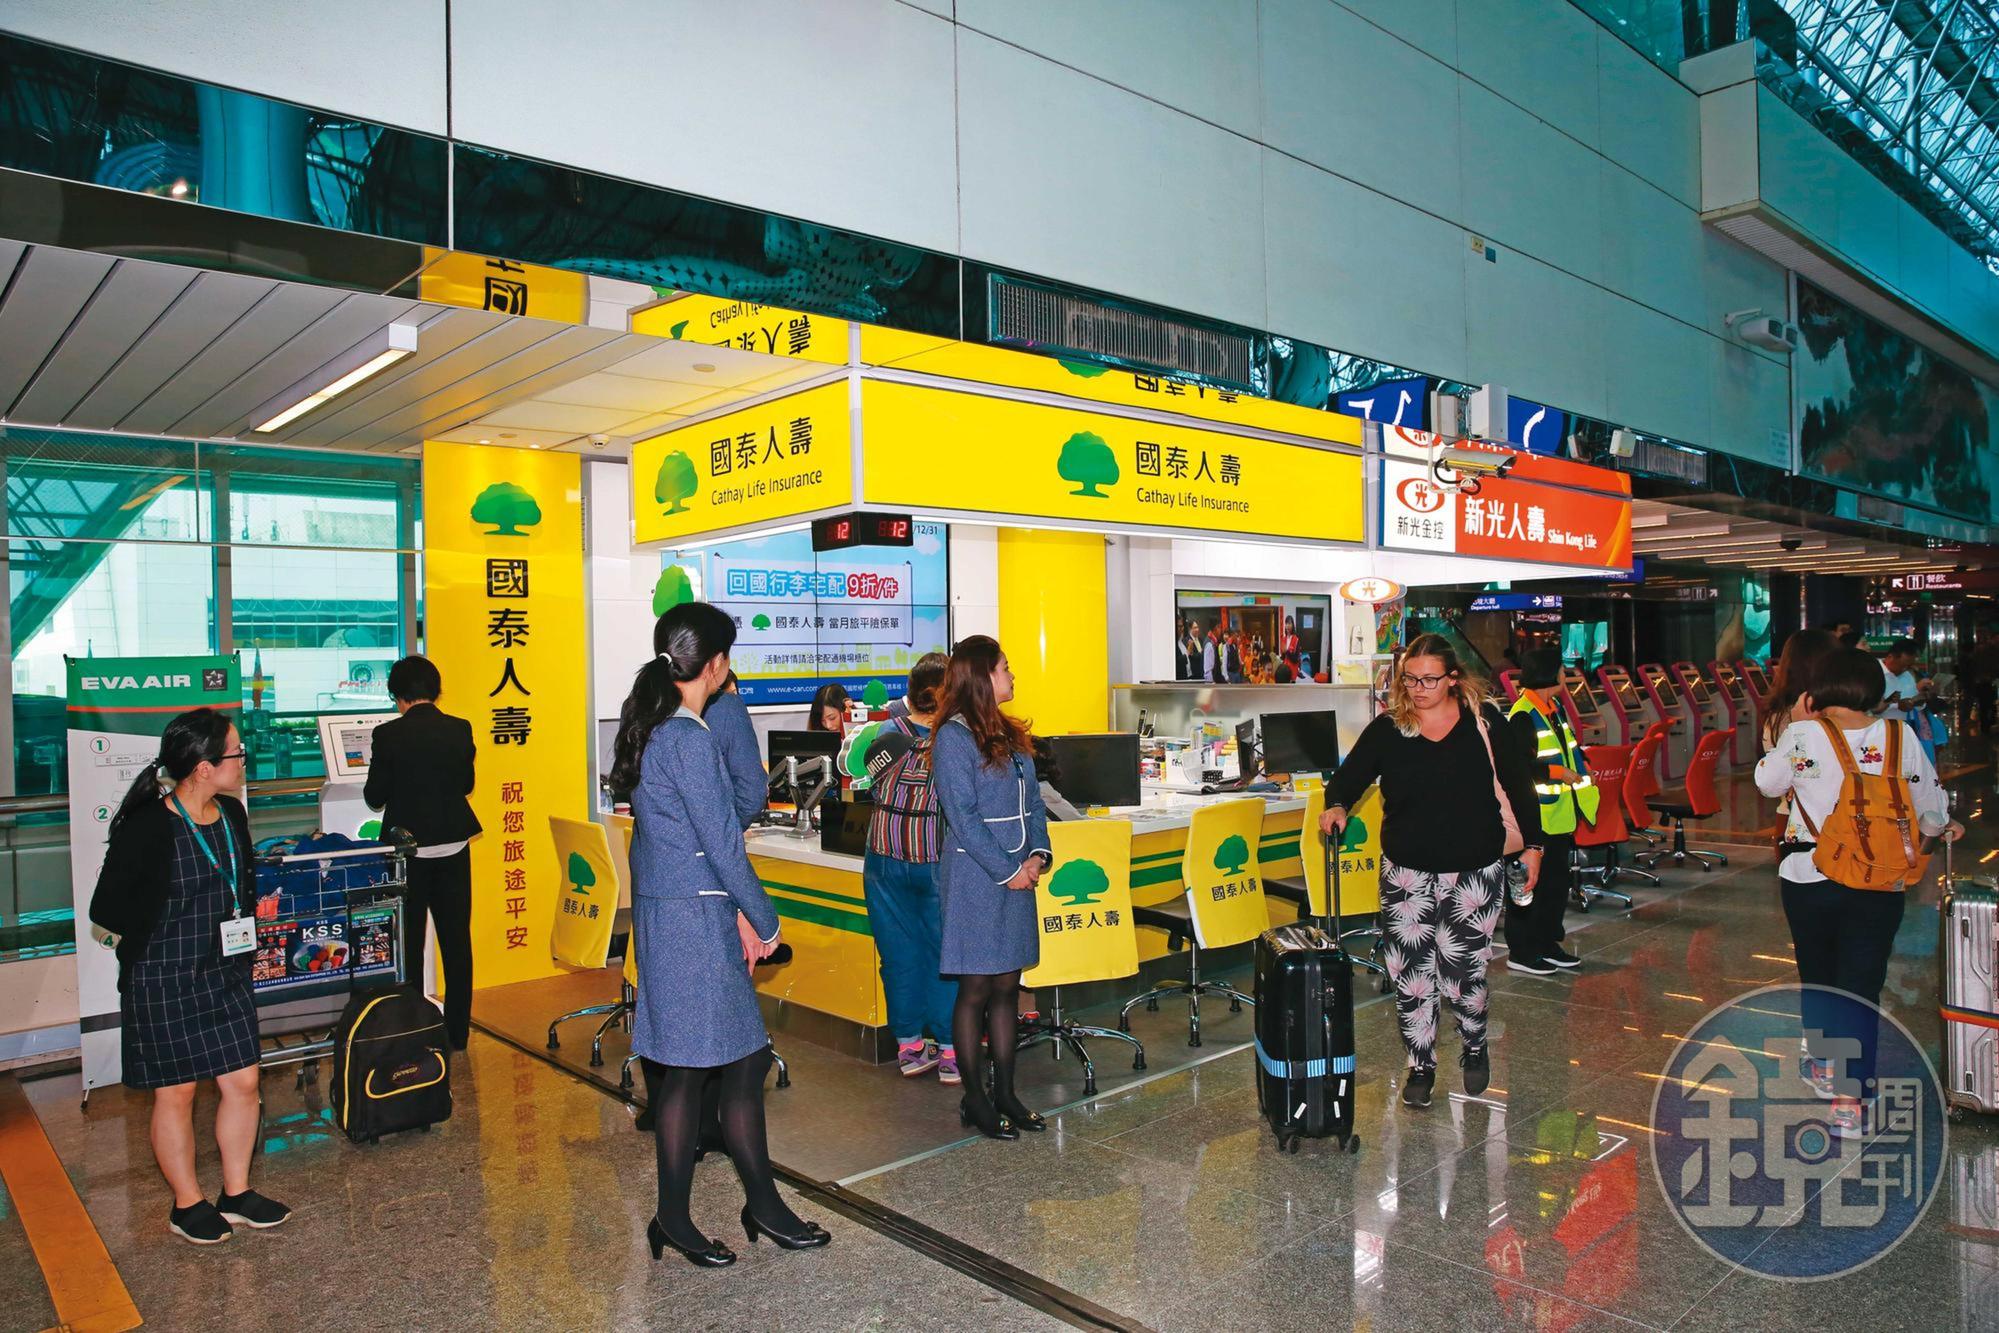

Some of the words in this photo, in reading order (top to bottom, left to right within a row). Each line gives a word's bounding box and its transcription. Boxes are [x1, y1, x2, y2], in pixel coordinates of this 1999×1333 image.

[710, 416, 813, 477] 國泰人壽
[1136, 441, 1241, 486] 國泰人壽
[711, 483, 745, 506] Cathay
[747, 480, 766, 499] Life
[769, 468, 823, 495] Insurance
[1136, 487, 1176, 508] Cathay
[1178, 491, 1198, 508] Life
[1201, 494, 1250, 513] Insurance
[1397, 515, 1444, 541] 新光金控
[1464, 495, 1546, 543] 新光人壽
[1547, 528, 1564, 545] Shin
[1565, 531, 1584, 552] Kong
[1584, 534, 1598, 549] Life
[486, 558, 532, 746] 國泰人壽
[501, 781, 529, 950] 祝您旅途平安
[1211, 877, 1257, 902] 國泰人壽
[302, 923, 343, 940] KSS
[1043, 910, 1120, 933] 國泰人壽
